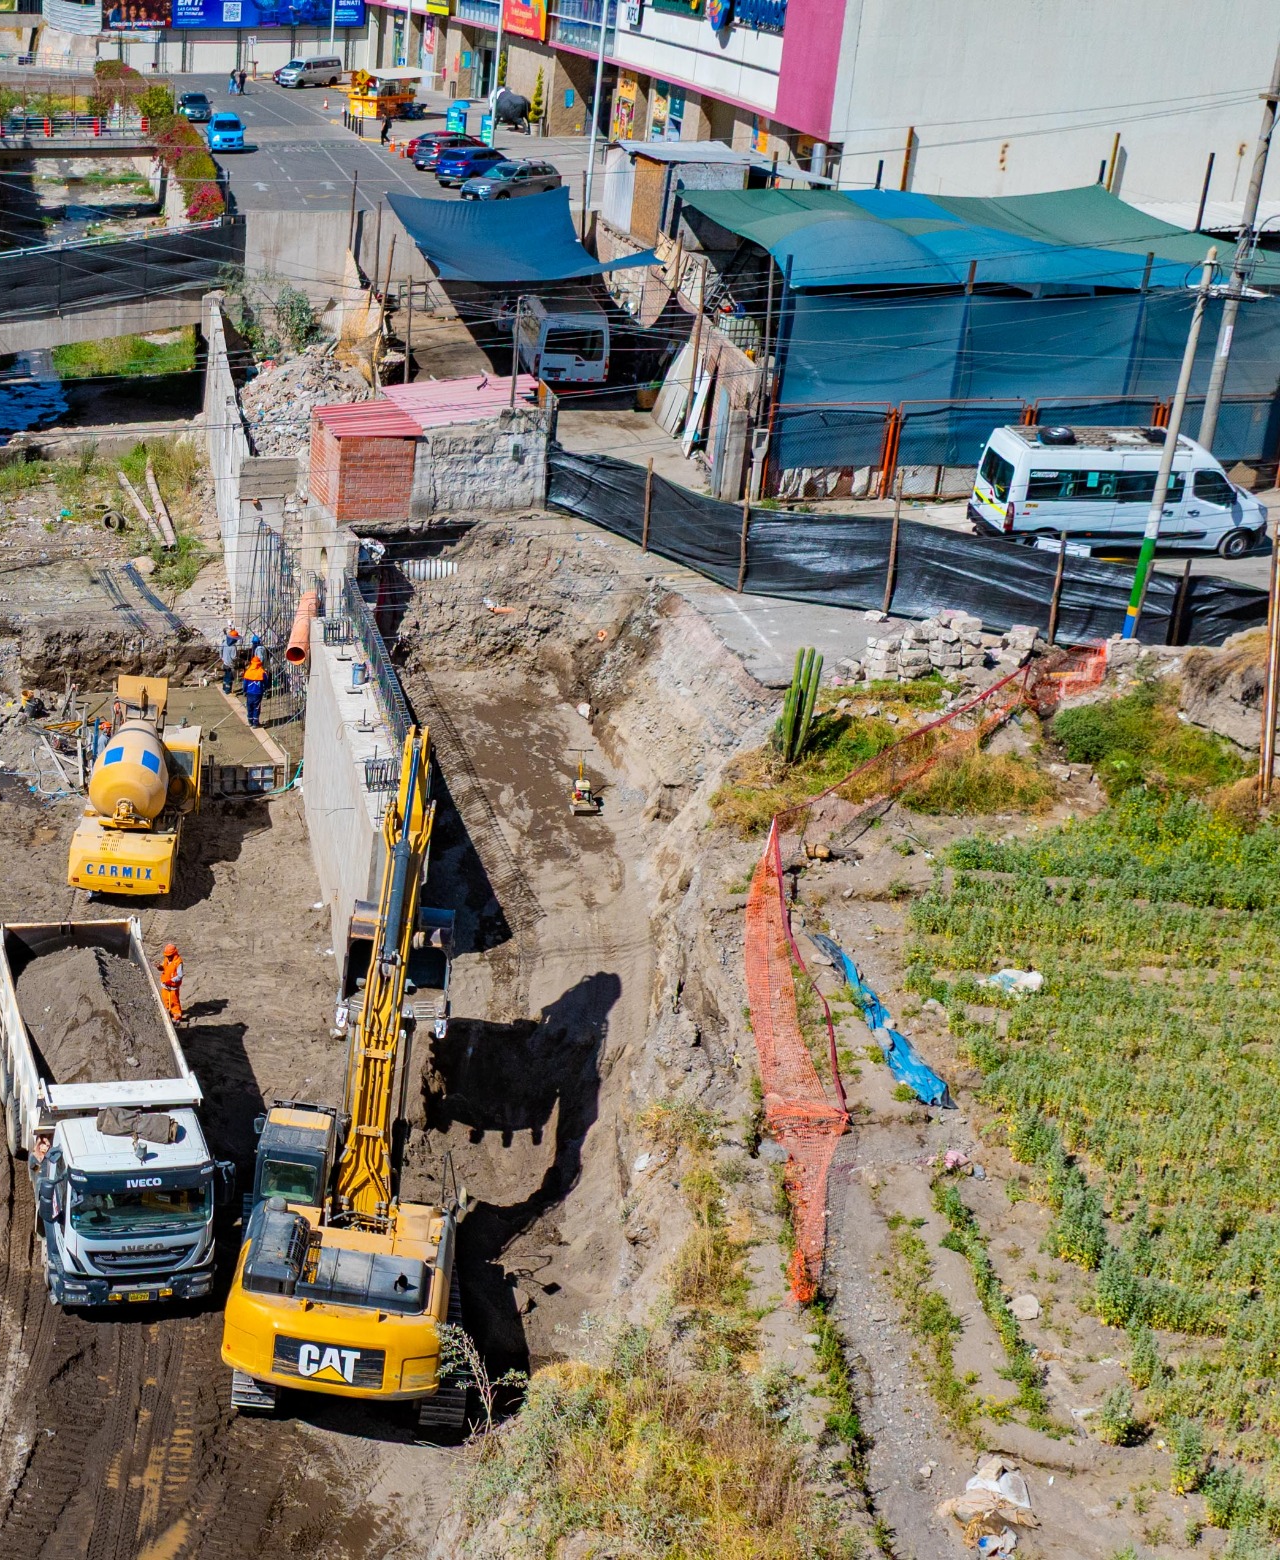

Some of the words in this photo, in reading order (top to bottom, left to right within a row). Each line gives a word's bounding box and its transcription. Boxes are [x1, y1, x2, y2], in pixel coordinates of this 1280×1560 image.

[626, 6, 638, 21] KFC
[86, 863, 152, 880] CARMIX
[126, 1177, 162, 1189] IVECO
[298, 1343, 361, 1384] CAT
